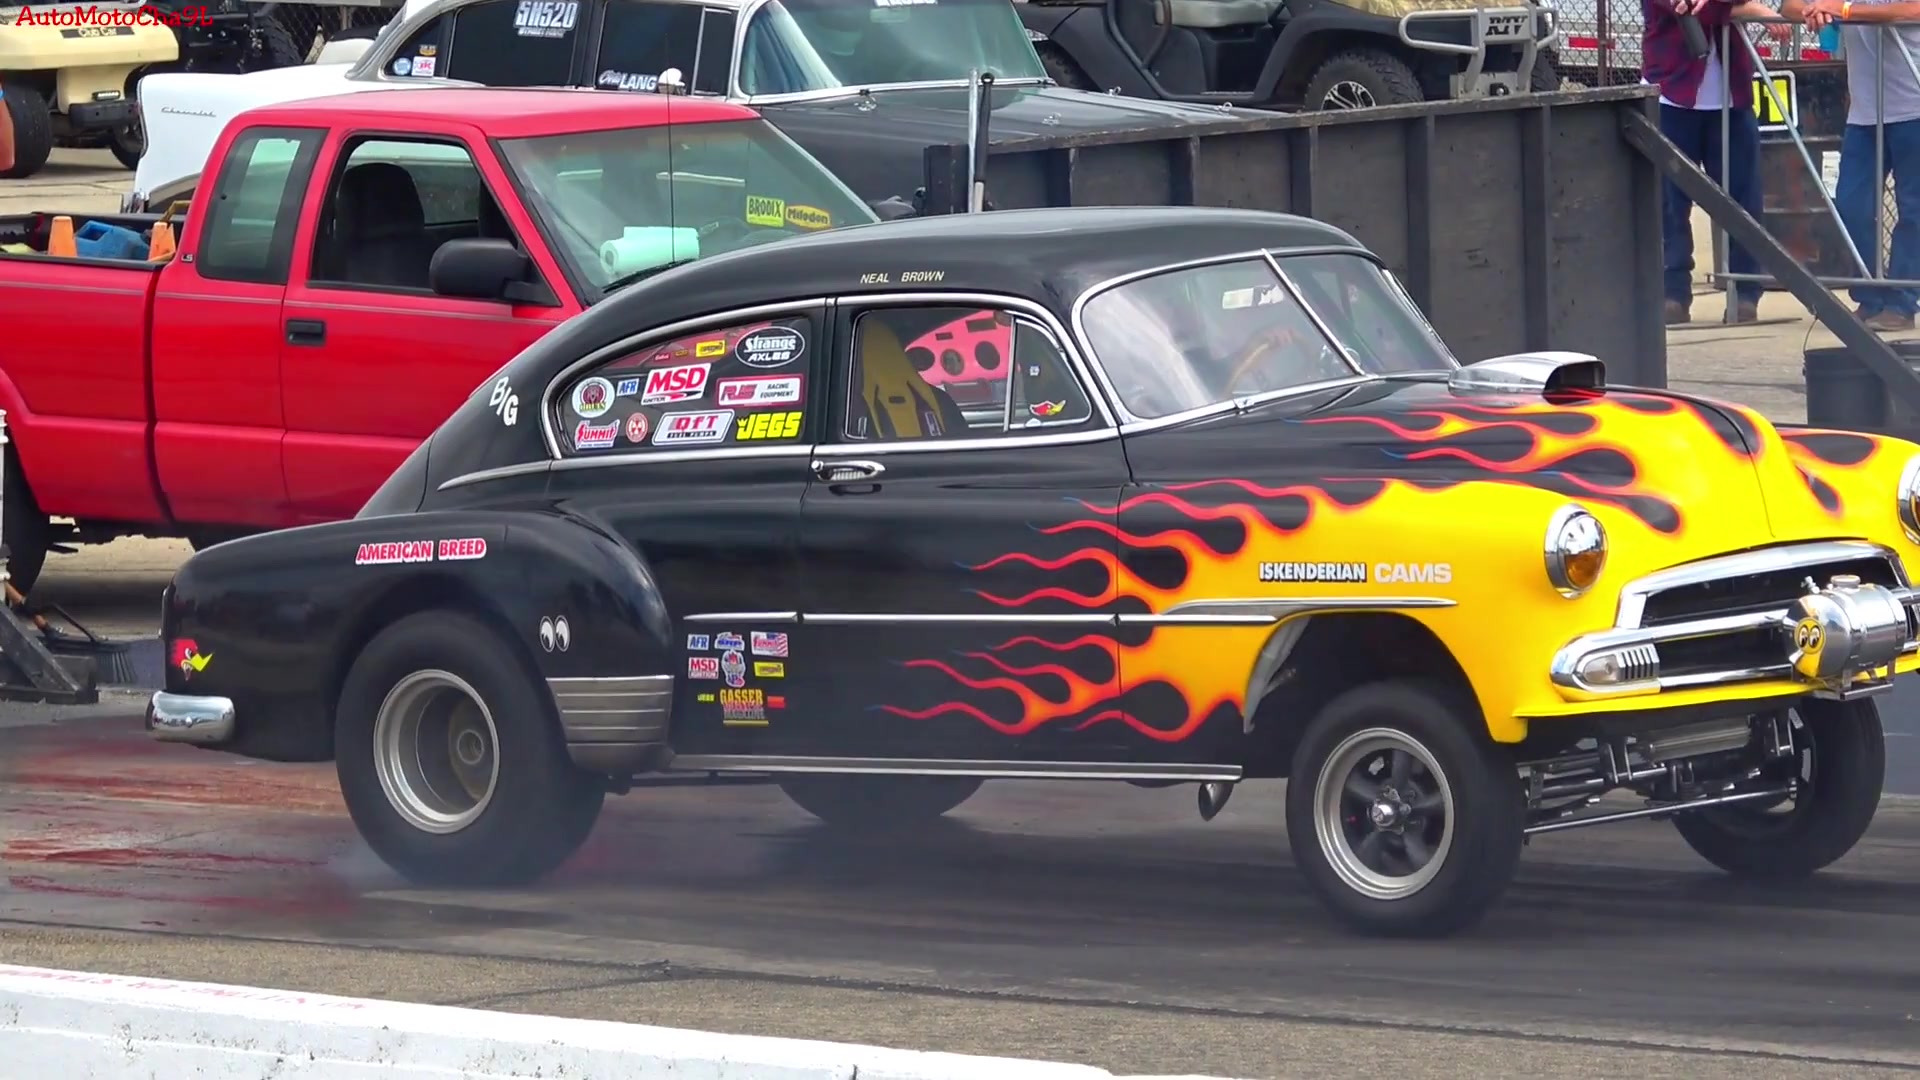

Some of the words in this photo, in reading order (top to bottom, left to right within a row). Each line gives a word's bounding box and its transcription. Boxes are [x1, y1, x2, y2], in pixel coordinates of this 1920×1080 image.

[515, 1, 578, 28] SH520
[619, 73, 657, 91] LANG
[748, 198, 782, 217] BRODIX
[860, 273, 890, 284] NEAL
[901, 271, 945, 282] BROWN
[744, 335, 797, 353] Strange
[619, 381, 638, 394] AFR
[647, 367, 706, 394] MSD
[736, 412, 802, 439] JEGS
[356, 541, 433, 564] AMERICAN
[439, 538, 487, 560] BREED
[1260, 562, 1367, 582] ISKENDERIAN
[1374, 562, 1452, 584] CAMS
[690, 636, 708, 649] AFR
[690, 659, 717, 672] MSD
[720, 688, 764, 705] GASSER
